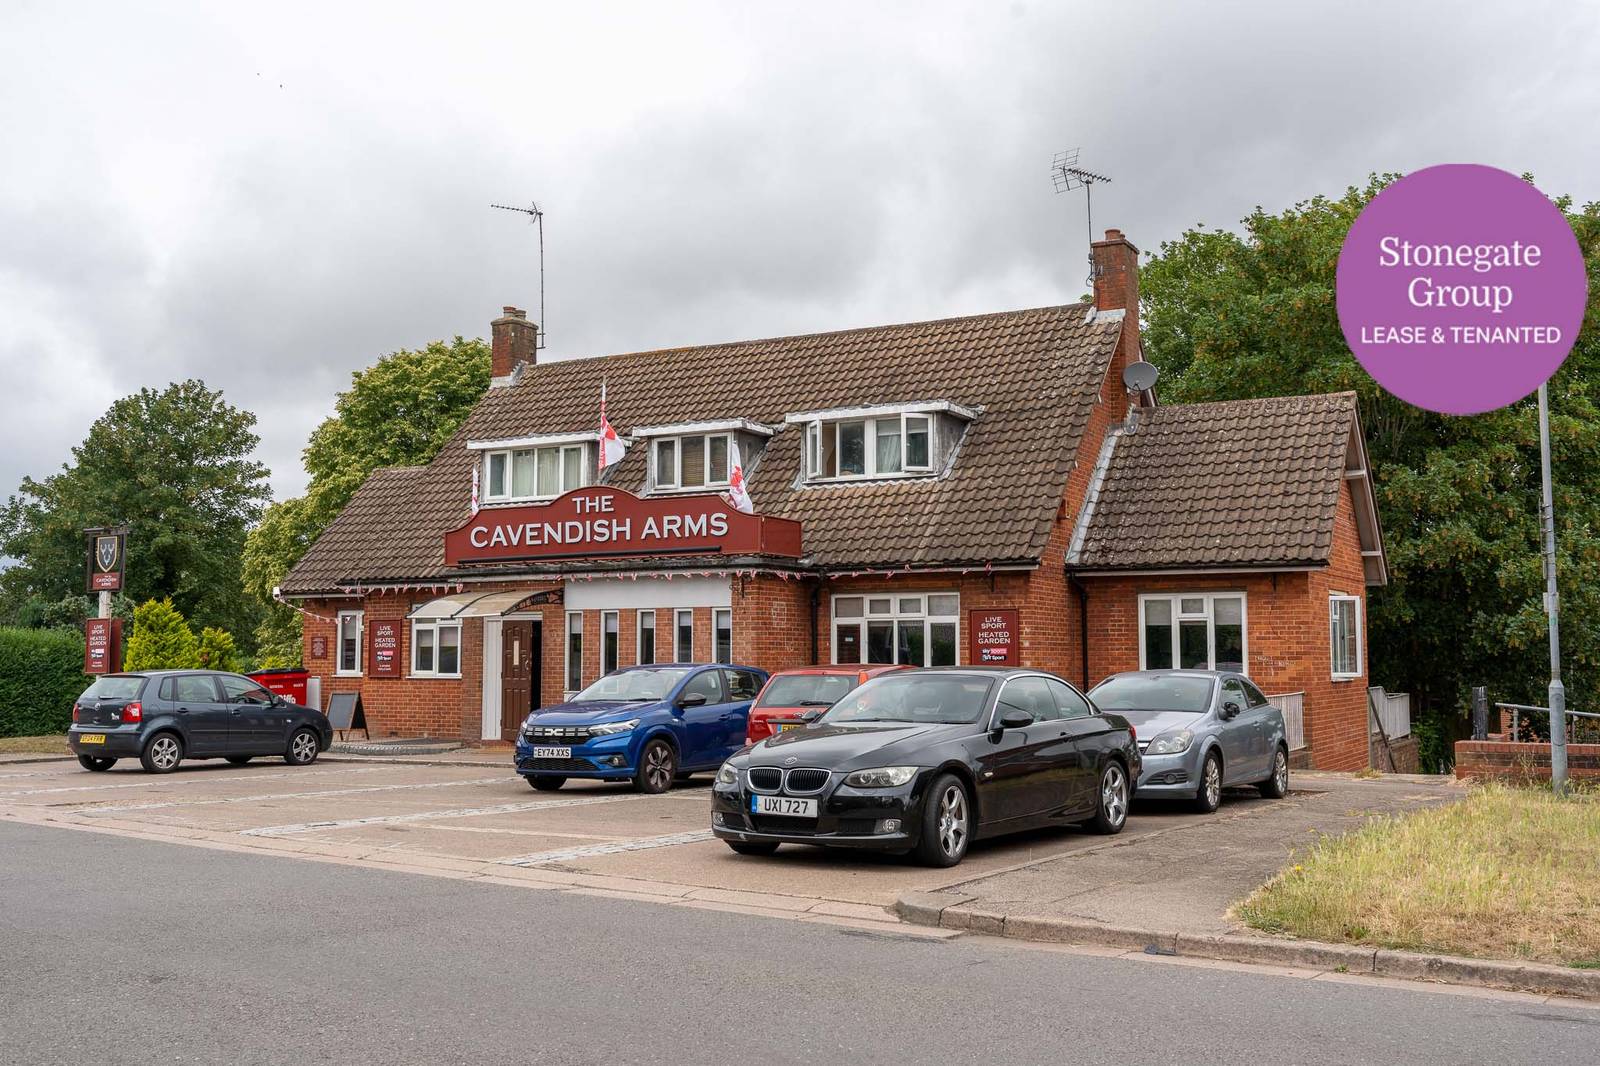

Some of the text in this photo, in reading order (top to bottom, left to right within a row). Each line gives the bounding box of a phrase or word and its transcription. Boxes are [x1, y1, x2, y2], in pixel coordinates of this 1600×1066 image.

[572, 495, 614, 514] THE
[470, 512, 729, 548] CAVENDISH ARMS
[537, 748, 570, 757] EY74 XXS
[764, 798, 809, 814] UXI 727
